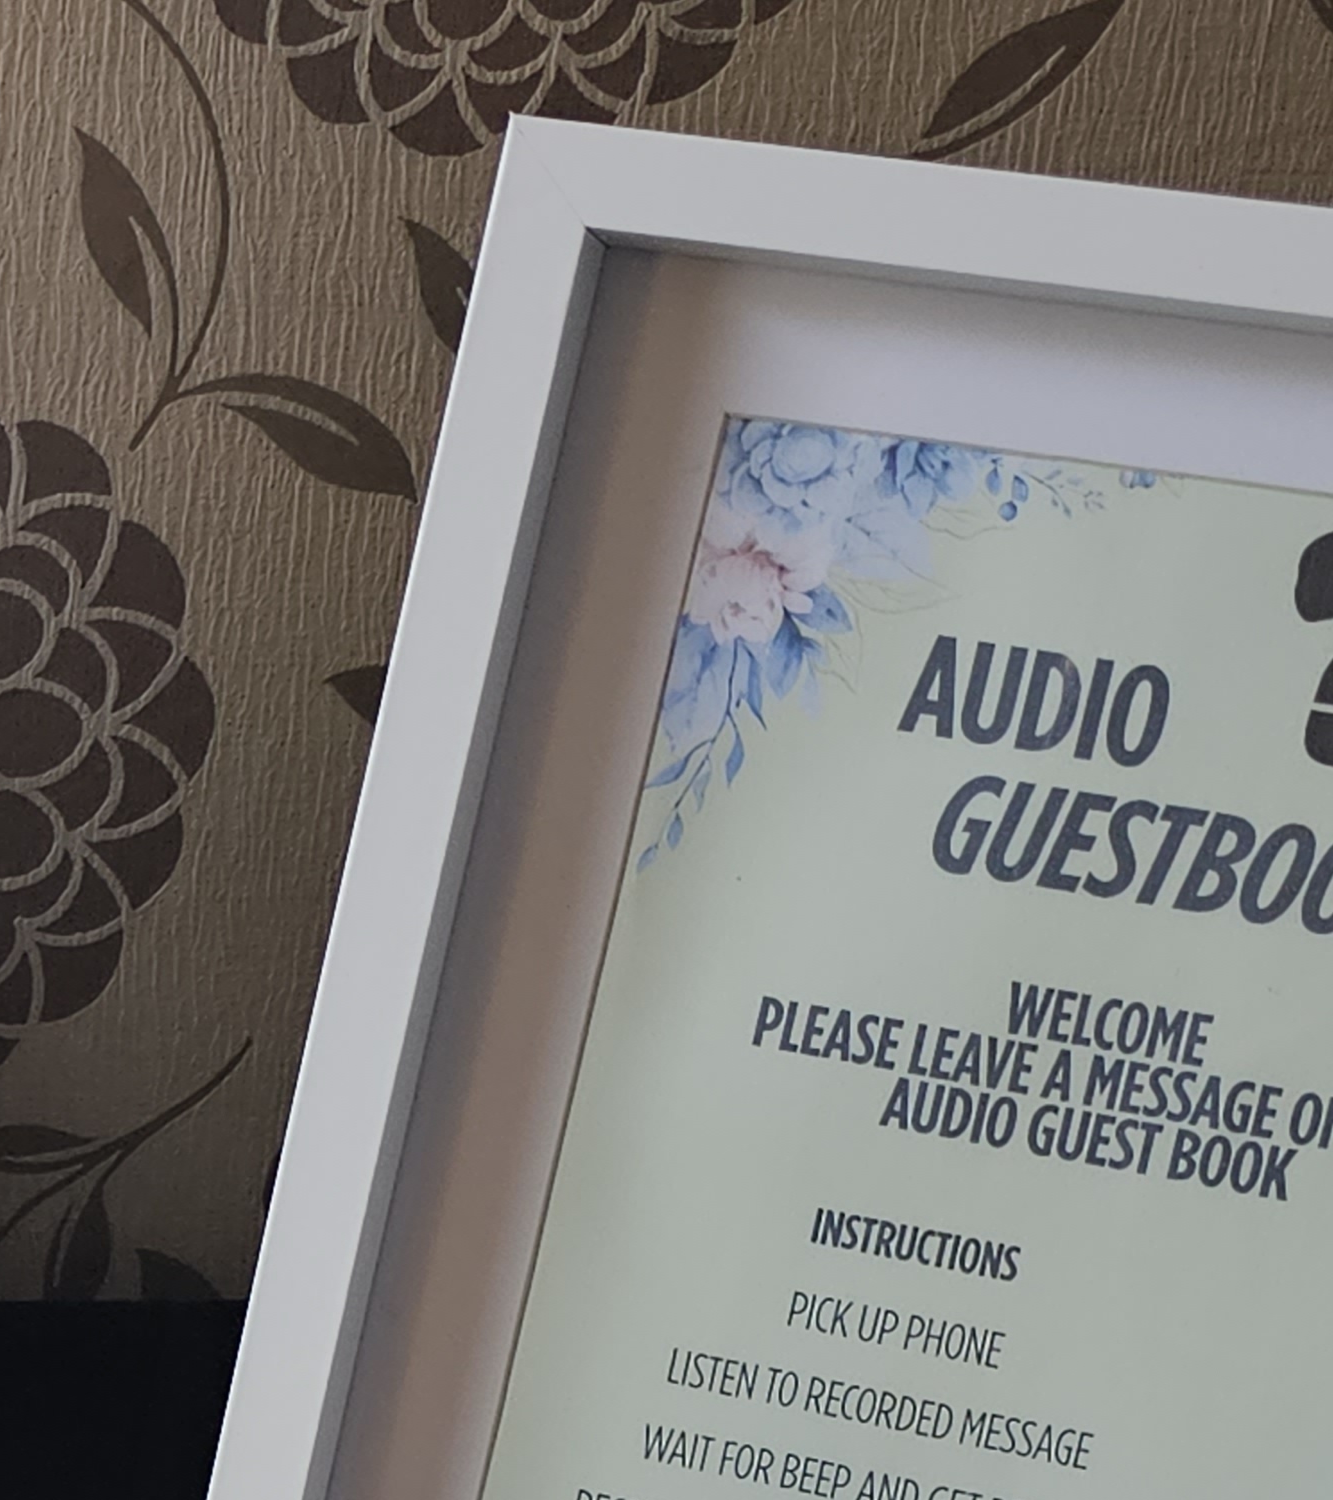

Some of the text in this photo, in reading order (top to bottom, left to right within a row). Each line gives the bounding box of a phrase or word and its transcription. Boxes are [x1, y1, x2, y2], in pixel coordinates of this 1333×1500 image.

[898, 635, 1170, 767] AUDIO
[752, 996, 904, 1070] PLEASE
[908, 1023, 1037, 1095] LEAVE
[1041, 1049, 1071, 1102] A
[1083, 1055, 1284, 1138] MESSAGE
[1008, 981, 1214, 1067] WELCOME
[879, 1078, 1298, 1201] AUDIO GUEST BOOK
[811, 1208, 1021, 1281] INSTRUCTIONS
[787, 1291, 1006, 1369] PICK UP PHONE
[644, 1423, 716, 1471] WAIT
[719, 1441, 775, 1485] FOR
[780, 1453, 851, 1499] BEEP
[667, 1348, 1095, 1470] LISTEN TO RECORDED MESSAGE
